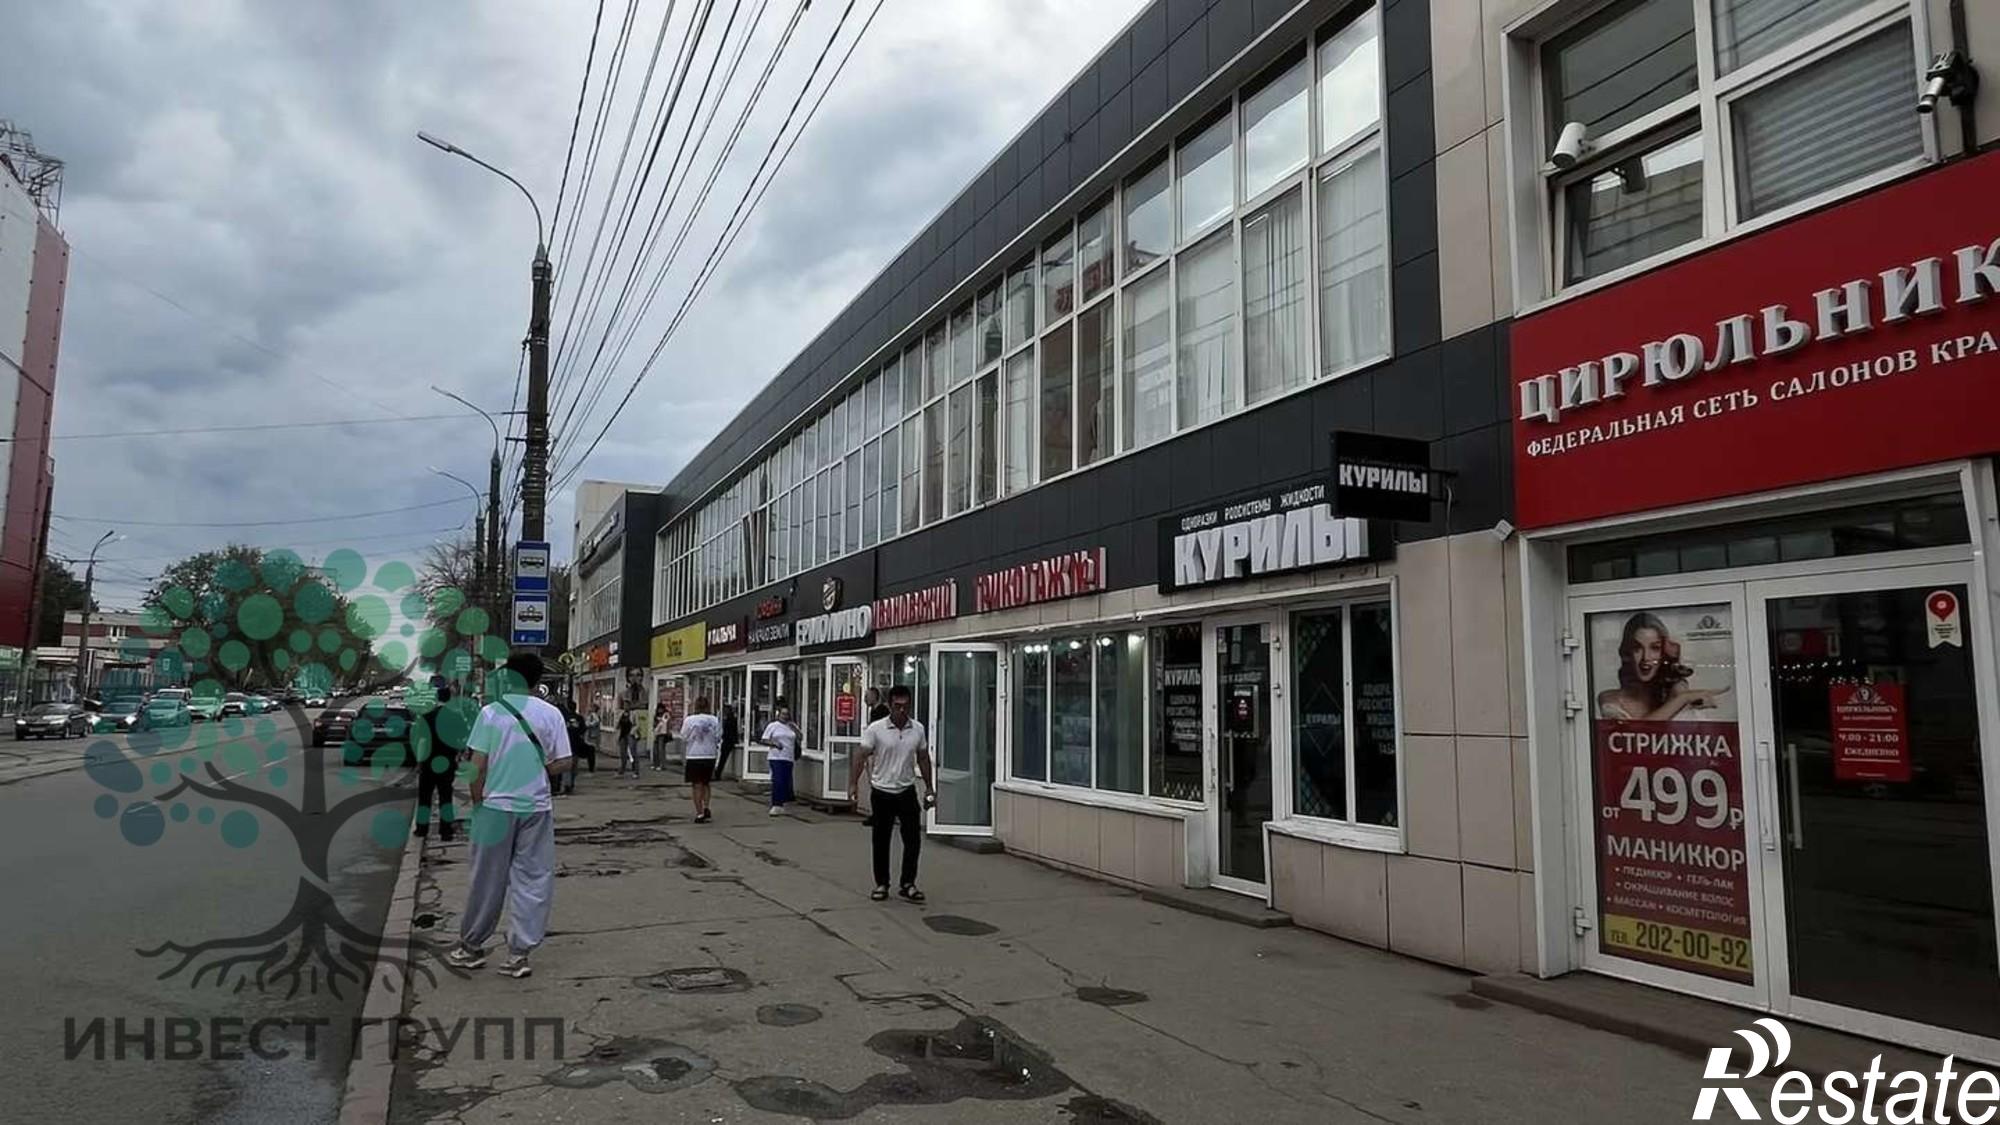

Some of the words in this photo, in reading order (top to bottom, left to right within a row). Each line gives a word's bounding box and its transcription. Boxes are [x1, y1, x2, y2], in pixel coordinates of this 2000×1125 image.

[1527, 405, 1685, 458] ФЕДЕРАЛЬНАЯ
[1694, 388, 1758, 419] СЕТЬ
[1770, 350, 1918, 401] САЛОНОВ
[1339, 463, 1428, 494] КУРИЛЫ
[1280, 485, 1325, 508] ЖИДКОСТИ
[1174, 503, 1369, 587] КУРИЛЫ
[797, 605, 872, 647] ЕРМОЛИНО
[1608, 731, 1732, 758] СТРИЖКА
[1607, 834, 1746, 872] МАНИКЮР
[1623, 866, 1673, 880] ПЕДИКЮР
[1624, 881, 1699, 901] ОКРАШИВАНИЕ
[1666, 905, 1747, 926] КОСМЕТОЛОГИЯ
[1636, 922, 1748, 969] 202-00-92
